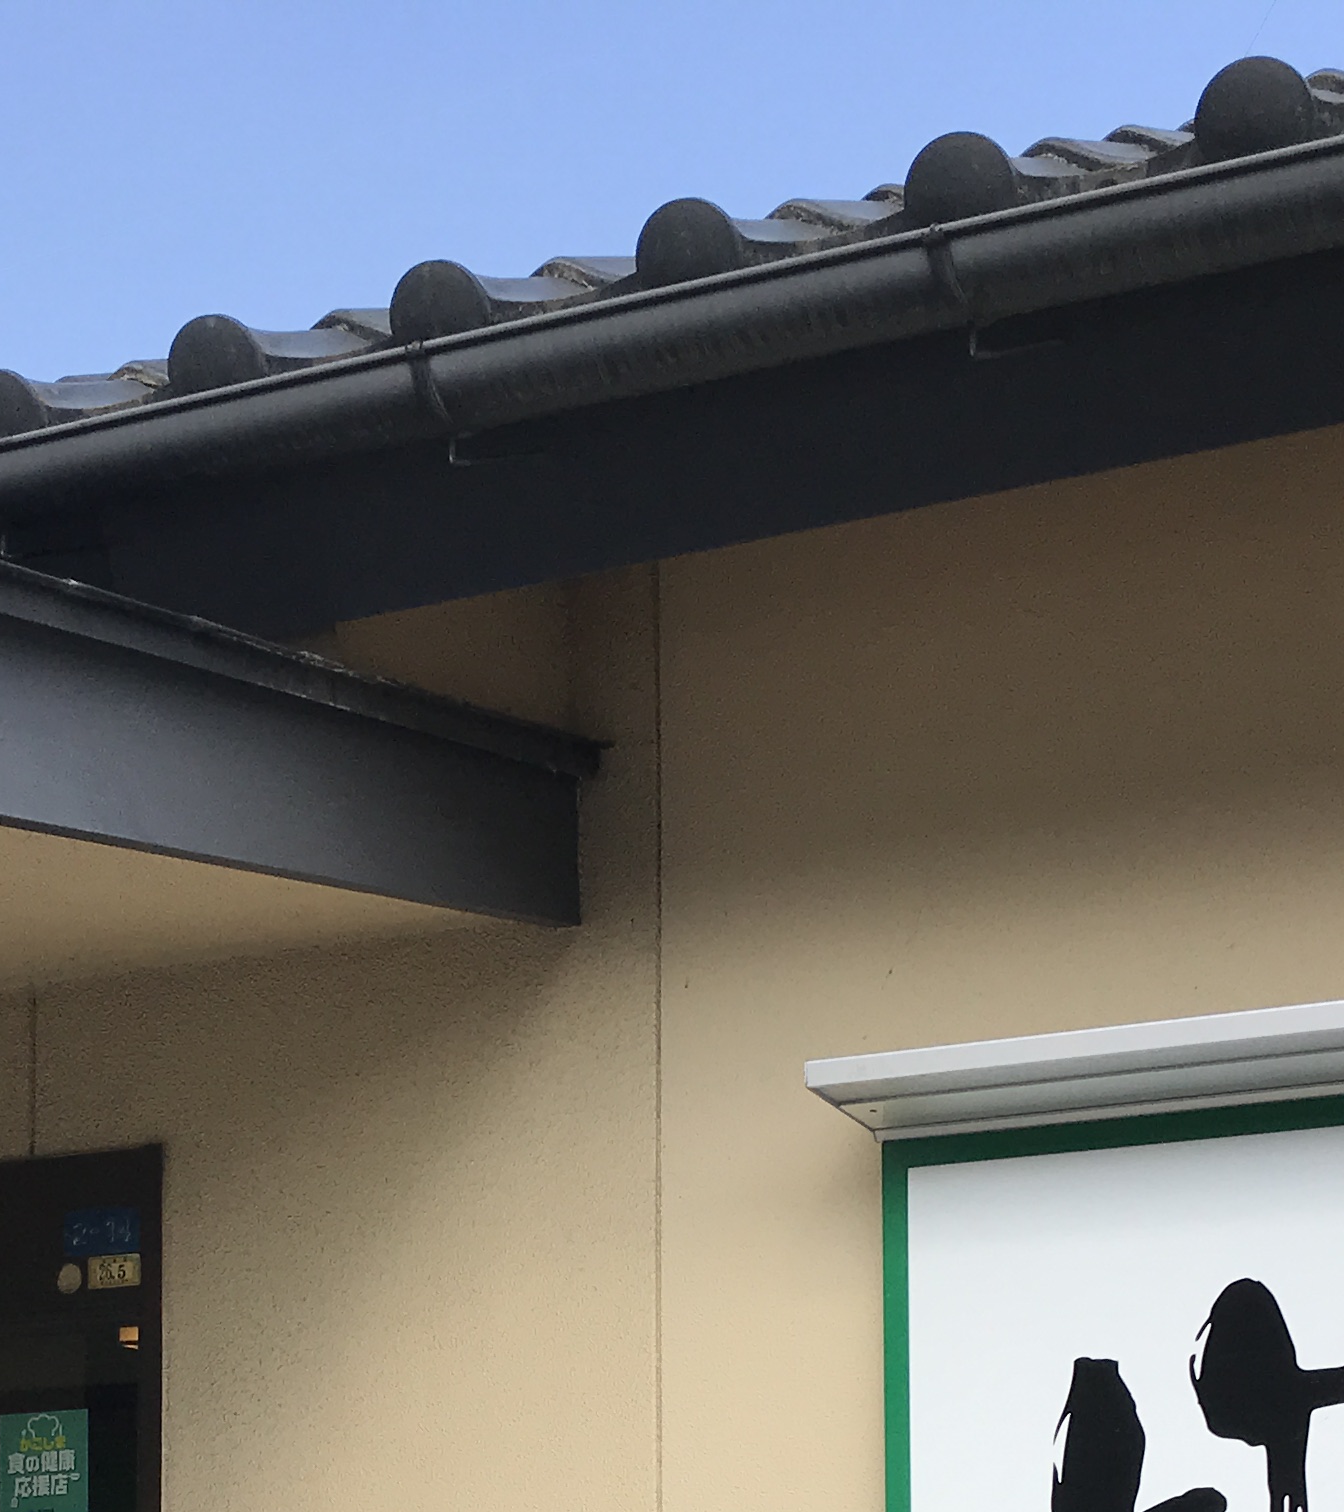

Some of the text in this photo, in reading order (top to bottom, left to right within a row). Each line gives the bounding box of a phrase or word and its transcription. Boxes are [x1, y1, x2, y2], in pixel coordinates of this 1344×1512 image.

[7, 1449, 76, 1475] 食の健康
[14, 1473, 69, 1498] 応援店
